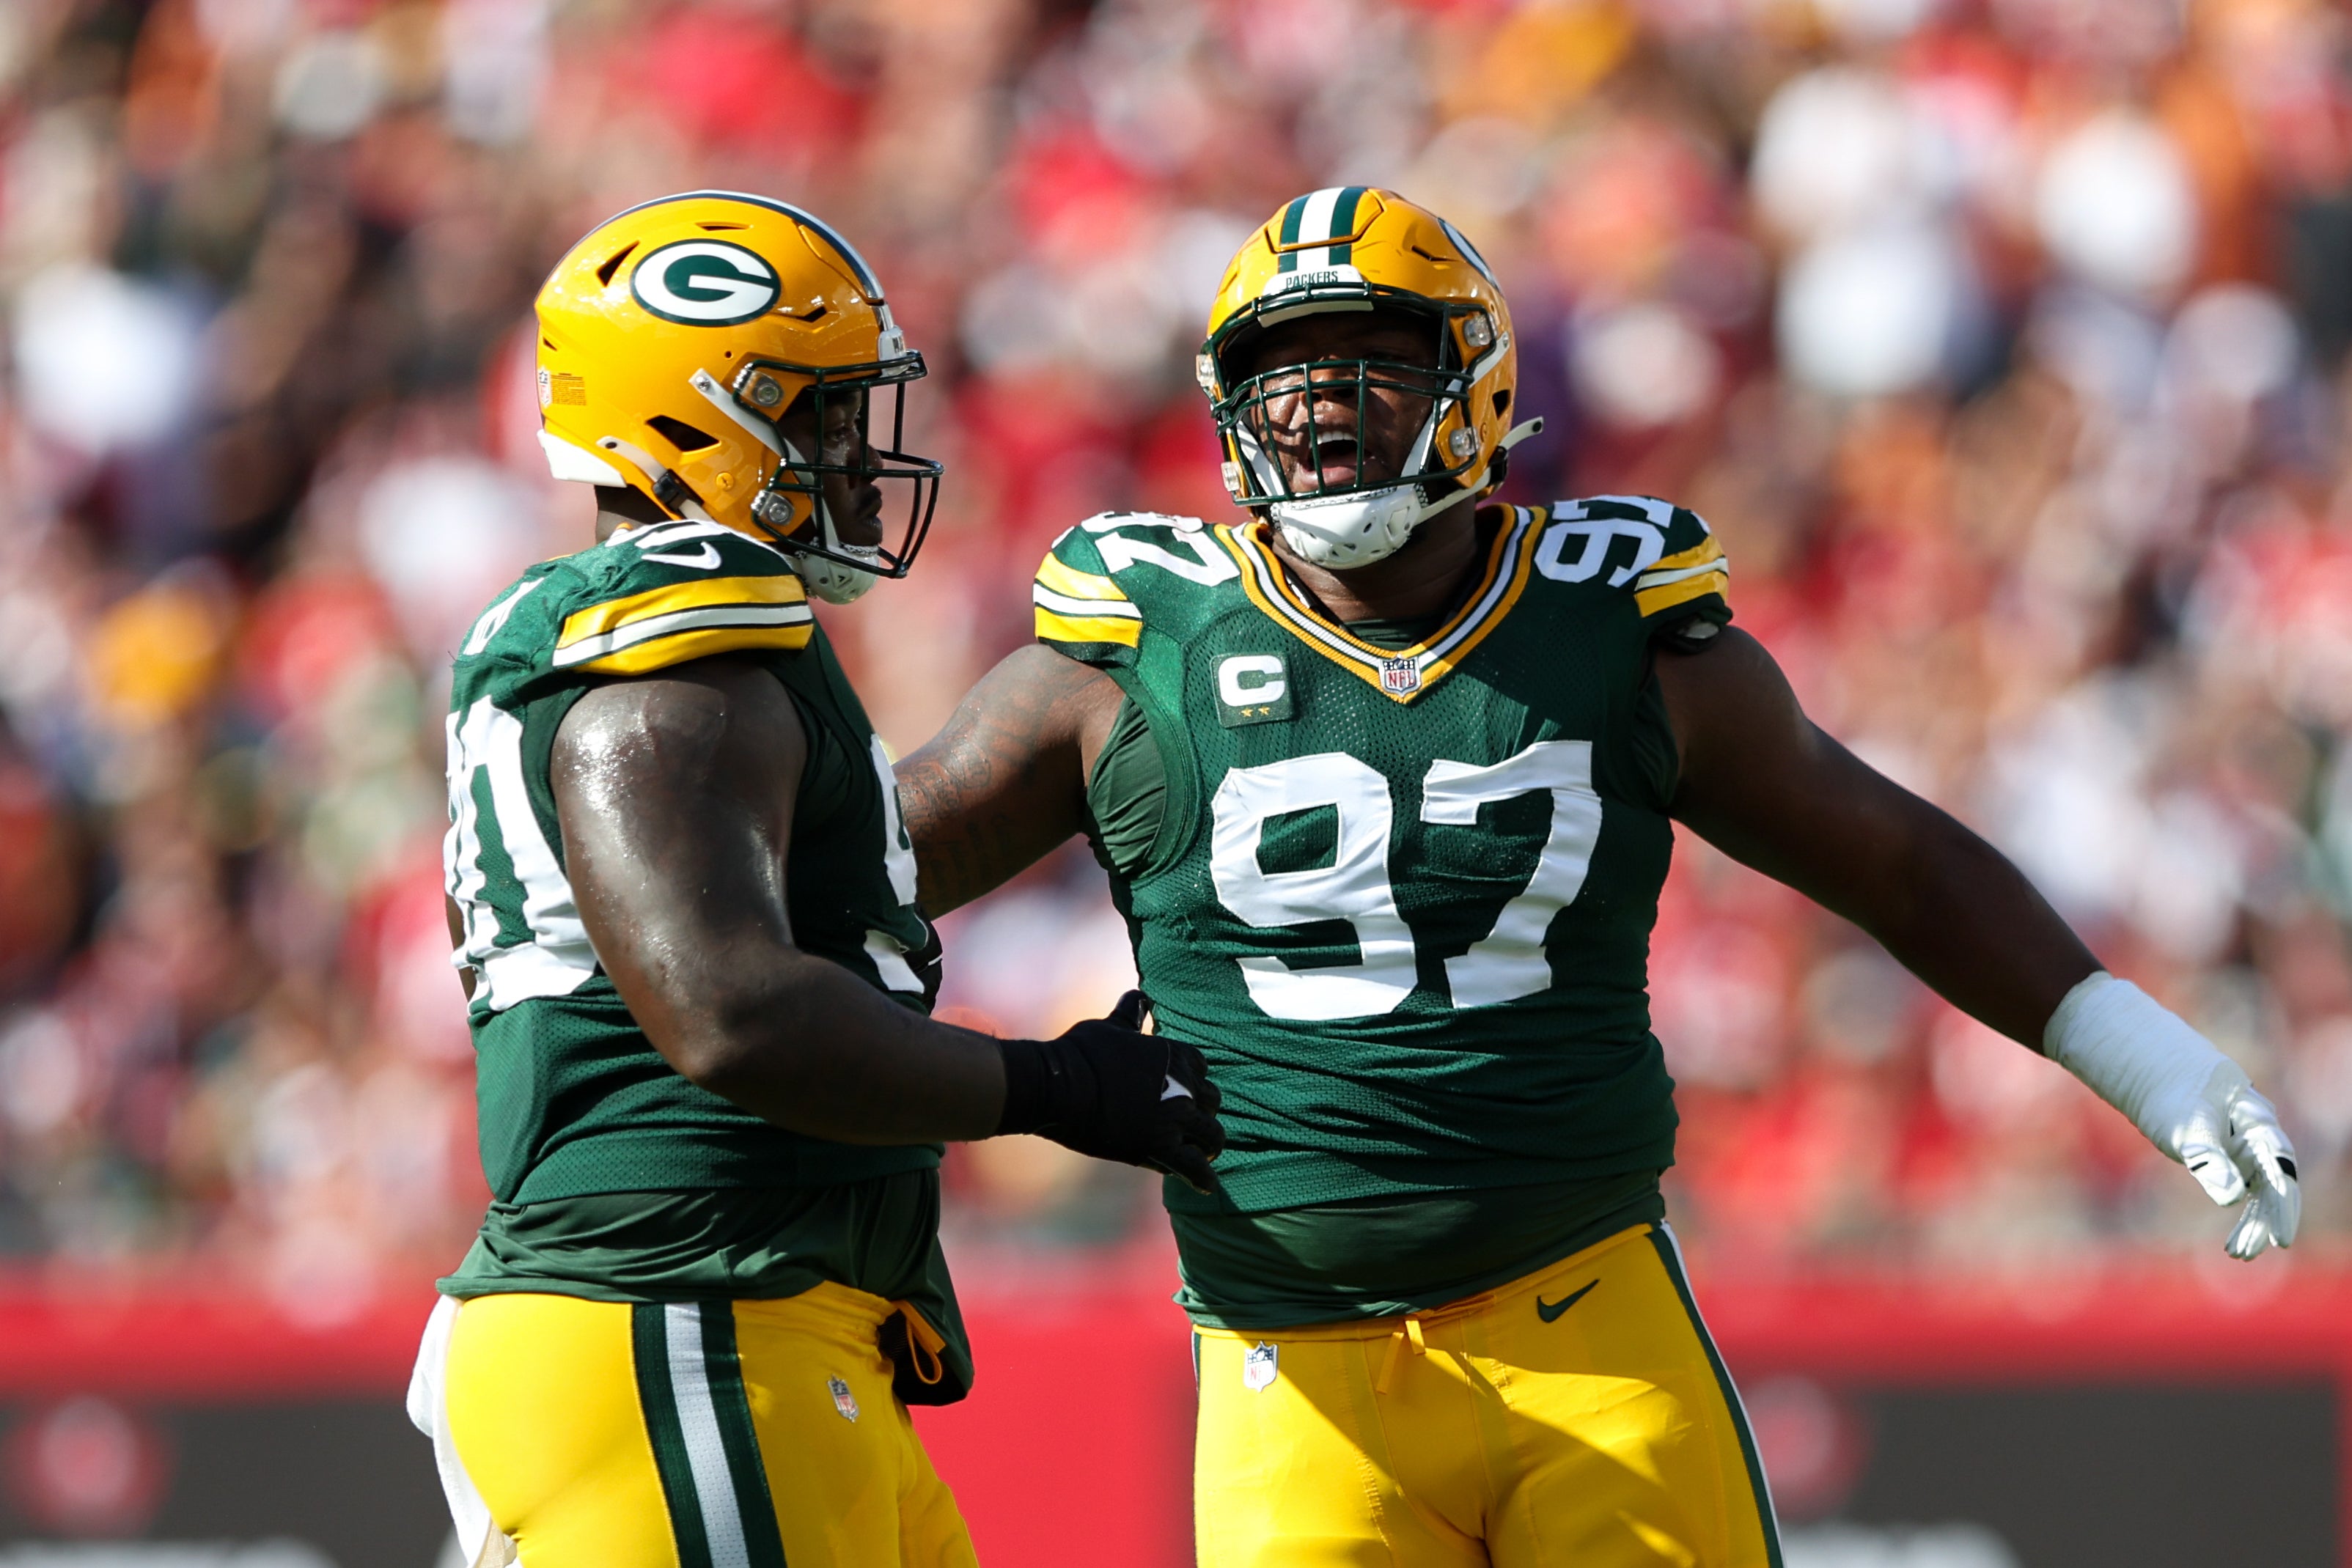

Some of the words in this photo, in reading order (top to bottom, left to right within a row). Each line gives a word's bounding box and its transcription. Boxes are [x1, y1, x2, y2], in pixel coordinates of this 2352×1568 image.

[634, 243, 773, 320] G
[1285, 270, 1339, 289] PACKERS
[1534, 494, 1674, 588] 97
[1219, 655, 1285, 707] C
[1388, 671, 1415, 688] NFL
[1209, 740, 1603, 1020] 97
